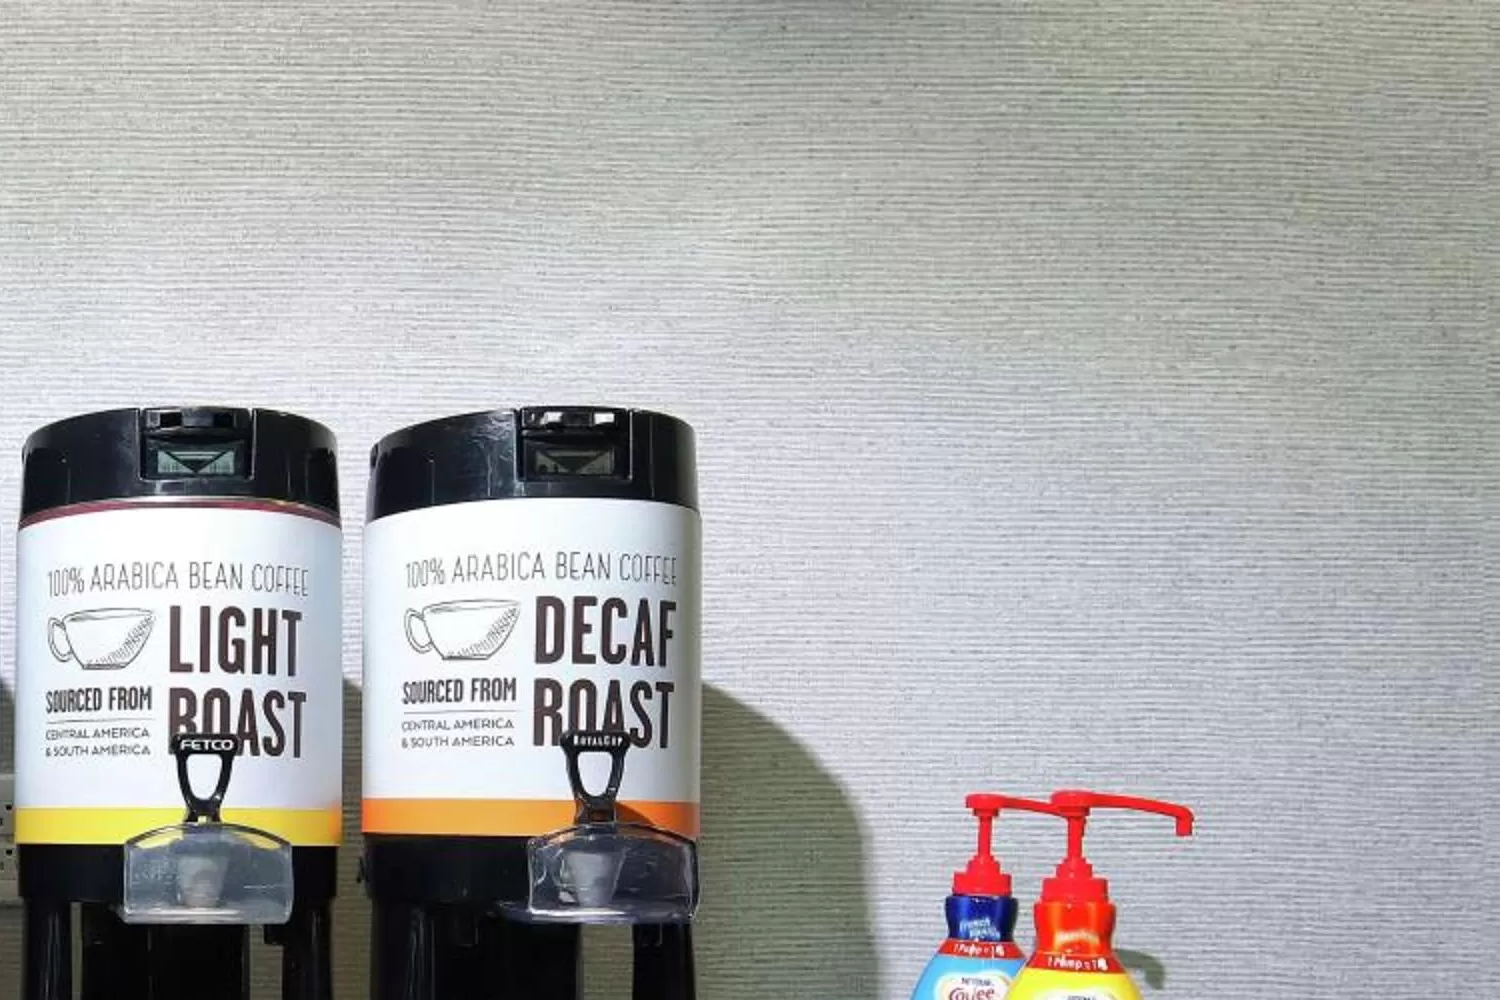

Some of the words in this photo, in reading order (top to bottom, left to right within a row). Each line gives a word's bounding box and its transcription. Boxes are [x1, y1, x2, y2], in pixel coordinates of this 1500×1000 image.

[48, 567, 85, 598] 100%
[89, 561, 179, 592] ARABICA
[189, 561, 243, 590] BEAN
[251, 563, 309, 597] COFFEE
[405, 557, 445, 589] 100%
[451, 551, 546, 583] ARABICA
[555, 551, 611, 580] BEAN
[618, 553, 677, 586] COFFEE
[169, 605, 303, 677] LIGHT
[534, 595, 677, 667] DECAF
[45, 688, 103, 714] SOURCED
[108, 685, 153, 711] FROM
[403, 680, 464, 705] SOURCED
[471, 678, 517, 702] FROM
[168, 687, 307, 758] ROAST
[401, 720, 451, 732] CENTRAL
[453, 717, 515, 730] AMERICA
[533, 678, 675, 749] ROAST
[45, 729, 90, 741] CENTRAL
[92, 727, 151, 739] AMERICA
[180, 739, 234, 751] FETCO
[411, 736, 449, 747] SOUTH
[451, 735, 515, 747] AMERICA
[53, 745, 90, 757] SOUTH
[91, 744, 151, 756] AMERICA
